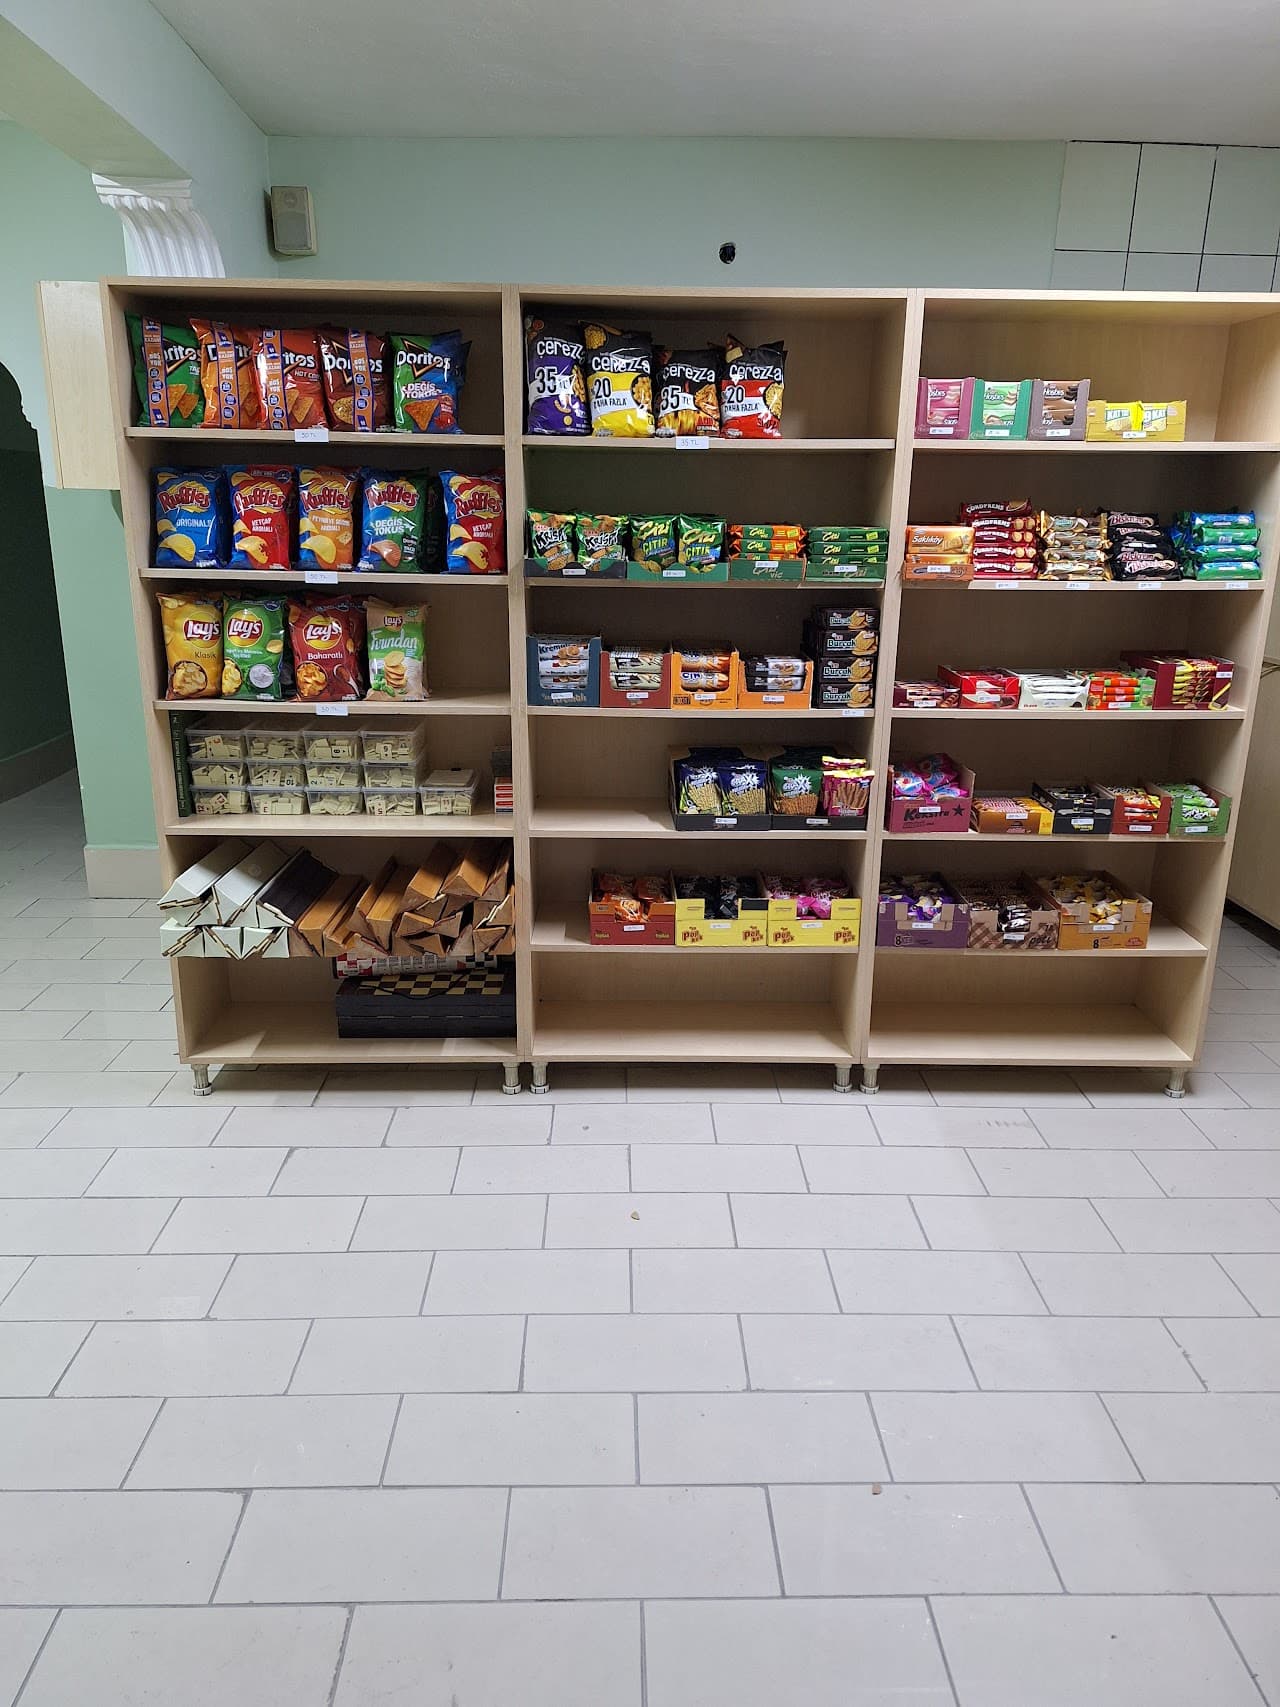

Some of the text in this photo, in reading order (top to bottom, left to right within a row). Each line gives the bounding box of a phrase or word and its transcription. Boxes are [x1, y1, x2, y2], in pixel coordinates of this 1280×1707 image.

[397, 350, 451, 370] Doritos
[535, 366, 557, 394] 35
[593, 377, 611, 399] 20
[660, 385, 681, 410] 35
[726, 385, 744, 404] 20
[740, 402, 759, 412] FAZLA
[157, 486, 210, 513] Ruffles
[234, 487, 286, 514] Ruffles
[365, 484, 420, 511] Ruffles
[454, 490, 503, 519] Ruffles
[228, 619, 262, 639] Lay's
